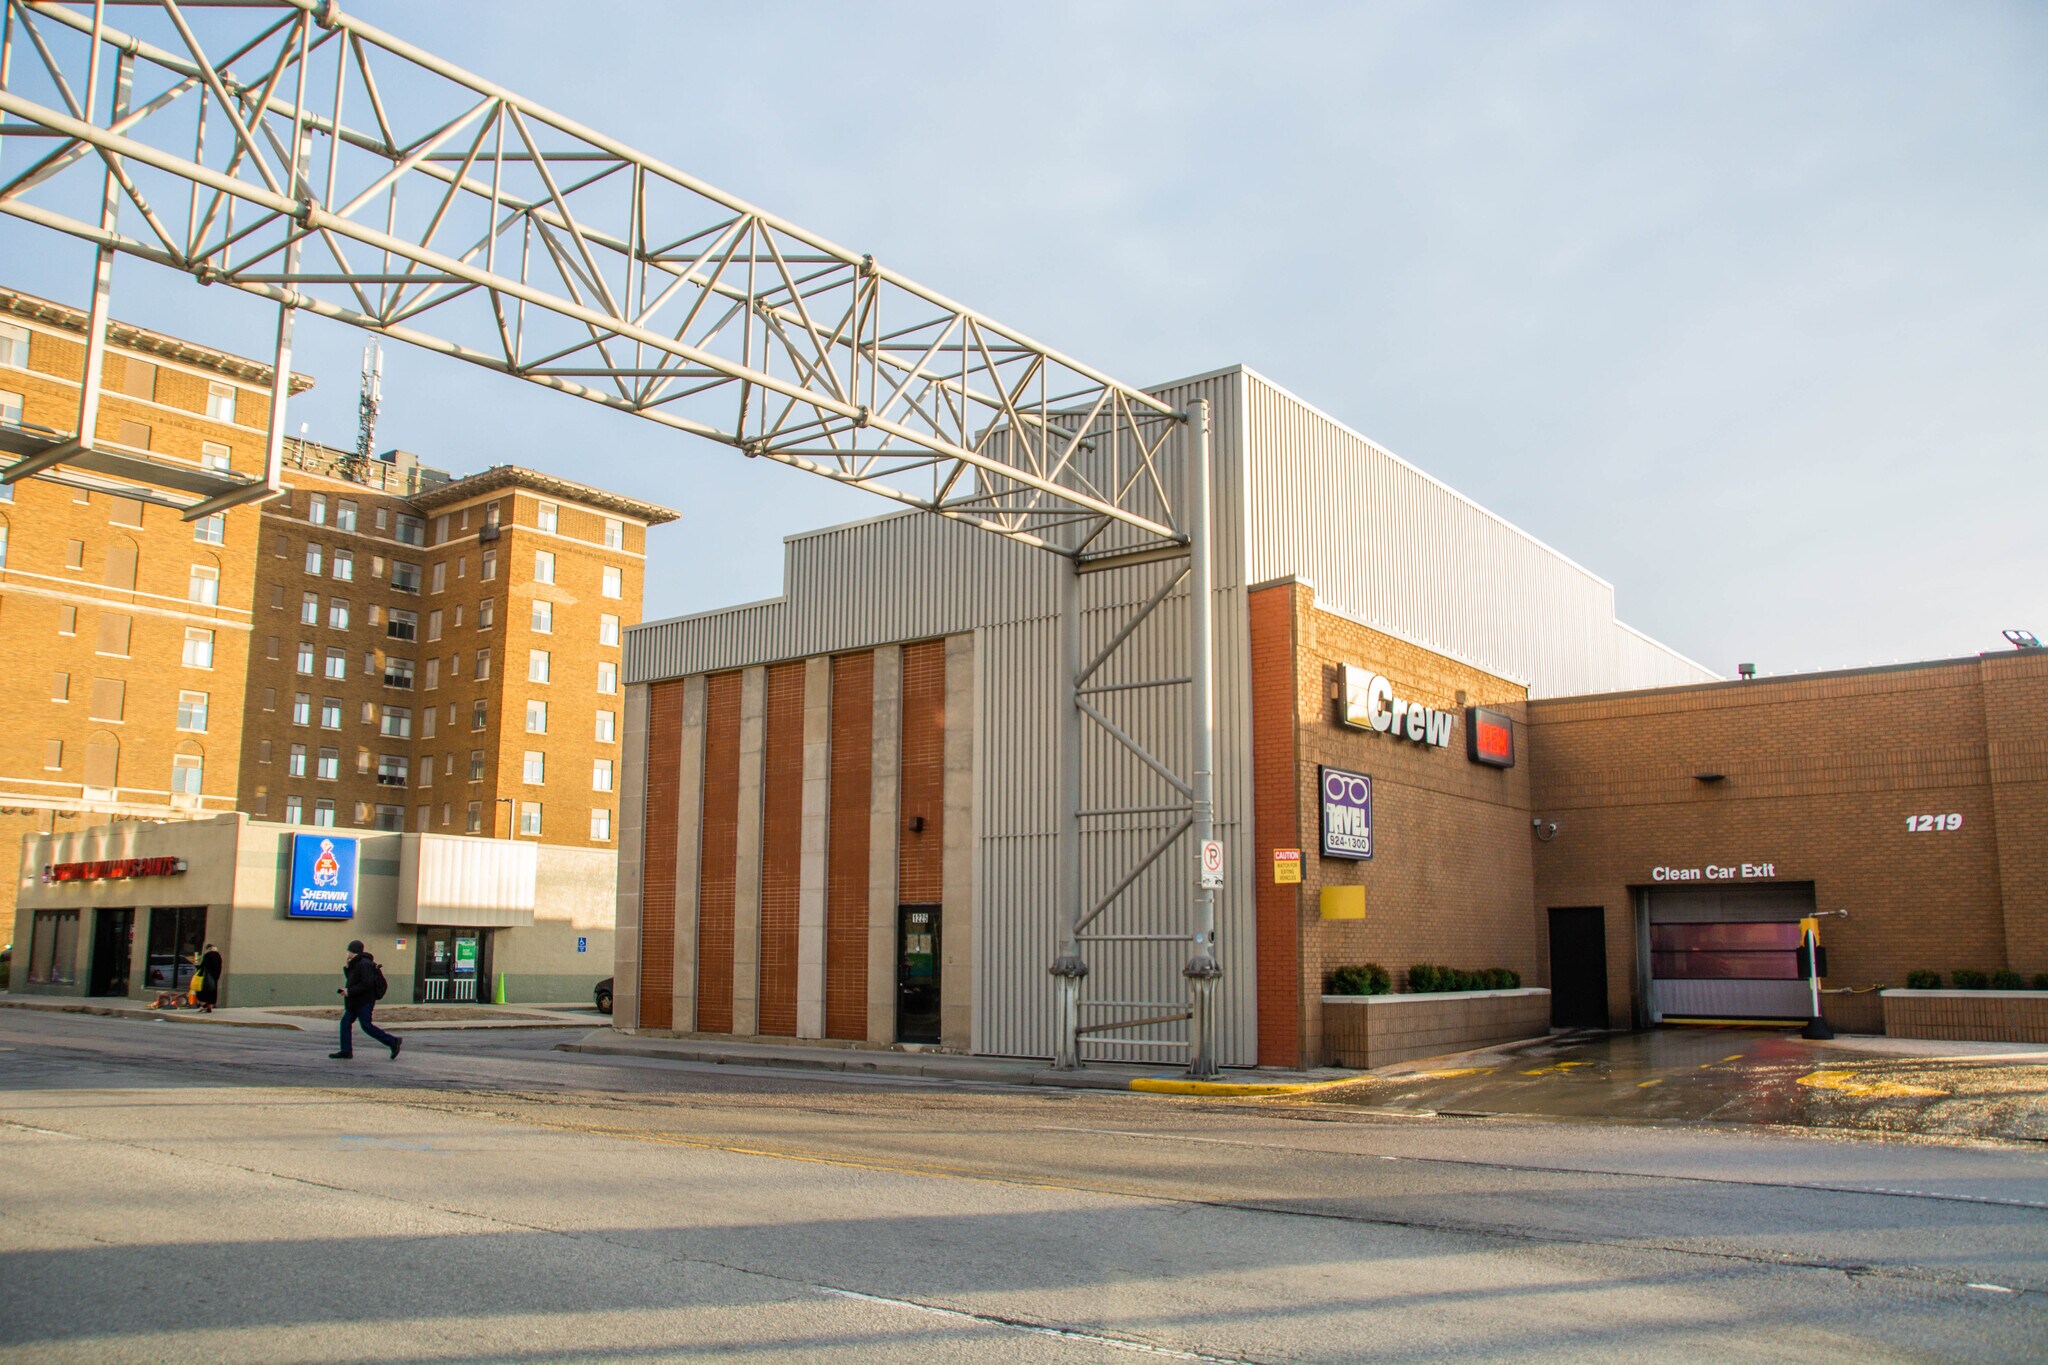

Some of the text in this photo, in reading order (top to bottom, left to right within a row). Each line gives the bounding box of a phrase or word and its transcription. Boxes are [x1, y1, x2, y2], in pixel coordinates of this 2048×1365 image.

[1368, 674, 1453, 749] Crew
[1326, 802, 1369, 838] TAVEL
[1906, 813, 1963, 832] 1219
[1329, 835, 1367, 849] 924-1300
[1275, 851, 1299, 860] CAUTION
[1652, 863, 1776, 881] Clean Car Exit
[300, 888, 348, 901] SHERWIN
[299, 900, 347, 912] WILLIAMS
